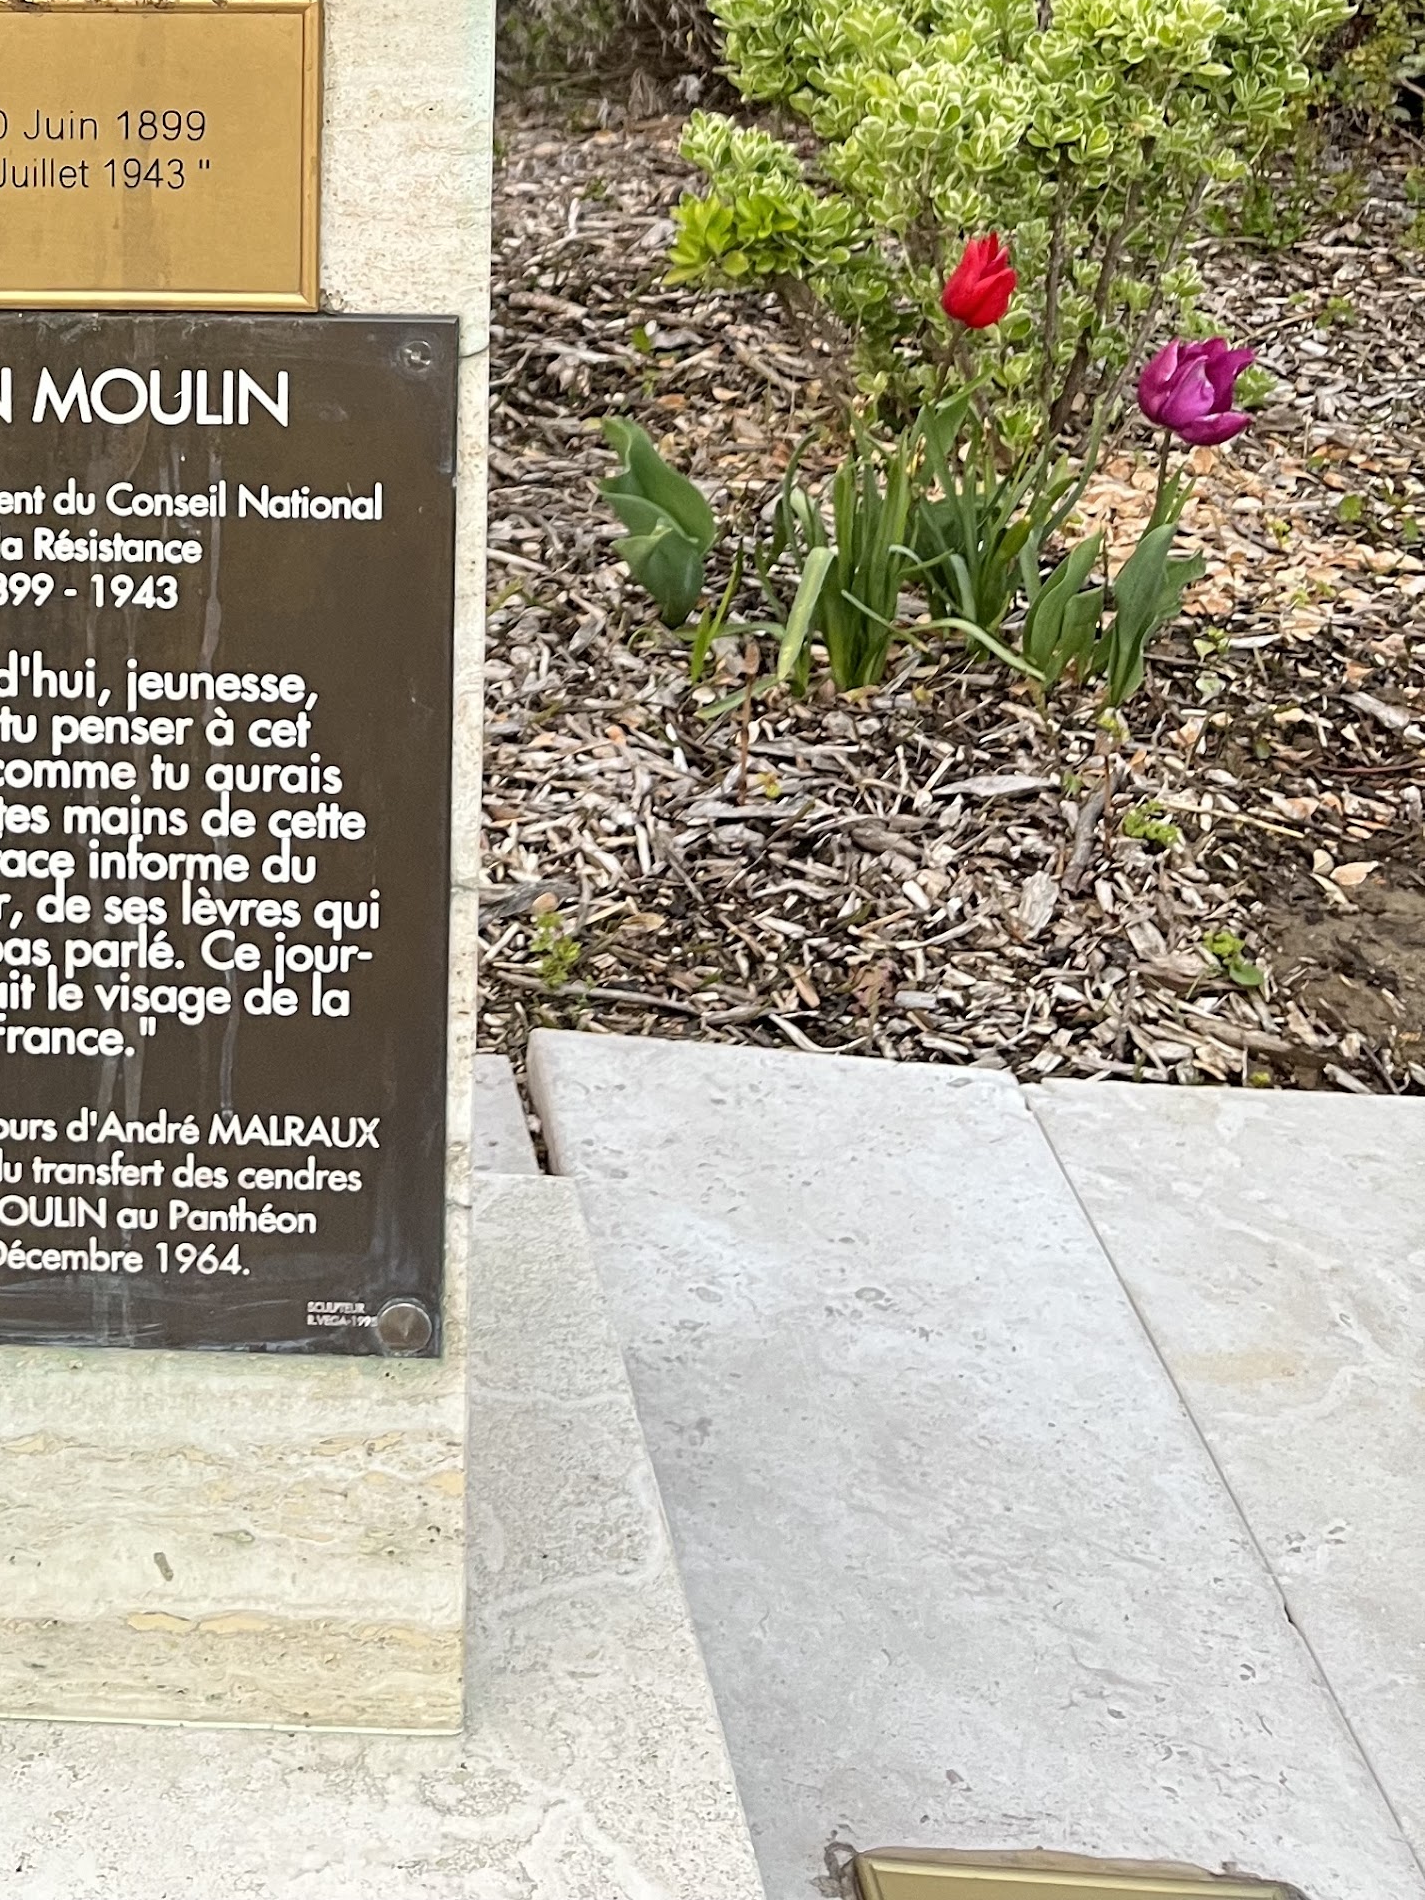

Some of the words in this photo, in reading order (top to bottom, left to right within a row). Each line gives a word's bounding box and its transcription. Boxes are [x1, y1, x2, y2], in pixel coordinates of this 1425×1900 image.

[23, 109, 99, 141] Juin
[116, 109, 208, 141] 1899
[103, 158, 186, 190] 1943
[32, 366, 289, 427] MOULIN
[53, 480, 97, 514] du
[106, 481, 227, 518] Conseil
[238, 483, 383, 521] National
[32, 528, 203, 563] Résistance
[90, 574, 179, 609] 1943
[127, 658, 319, 711] jeunesse,
[52, 715, 193, 755] penser
[206, 706, 234, 748] à
[248, 712, 311, 749] cet
[151, 754, 189, 791] tu
[205, 754, 342, 795] aurais
[63, 795, 187, 837] mains
[201, 791, 255, 838] de
[268, 803, 367, 840] cette
[89, 835, 249, 882] informe
[261, 836, 316, 883] du
[37, 876, 90, 924] de
[103, 894, 167, 925] ses
[183, 879, 301, 928] lèvres
[313, 890, 380, 939] qui
[65, 925, 184, 978] parlé.
[201, 930, 260, 968] Ce
[274, 933, 373, 984] jour-
[47, 966, 83, 1012] le
[95, 971, 231, 1025] visage
[243, 970, 298, 1015] de
[312, 971, 350, 1018] la
[65, 1108, 199, 1144] d'André
[210, 1115, 379, 1148] MALRAUX
[32, 1150, 164, 1187] transfert
[173, 1153, 227, 1188] des
[237, 1155, 362, 1192] cendres
[117, 1206, 159, 1231] au
[169, 1198, 316, 1233] Panthéon
[155, 1241, 250, 1275] 1964.
